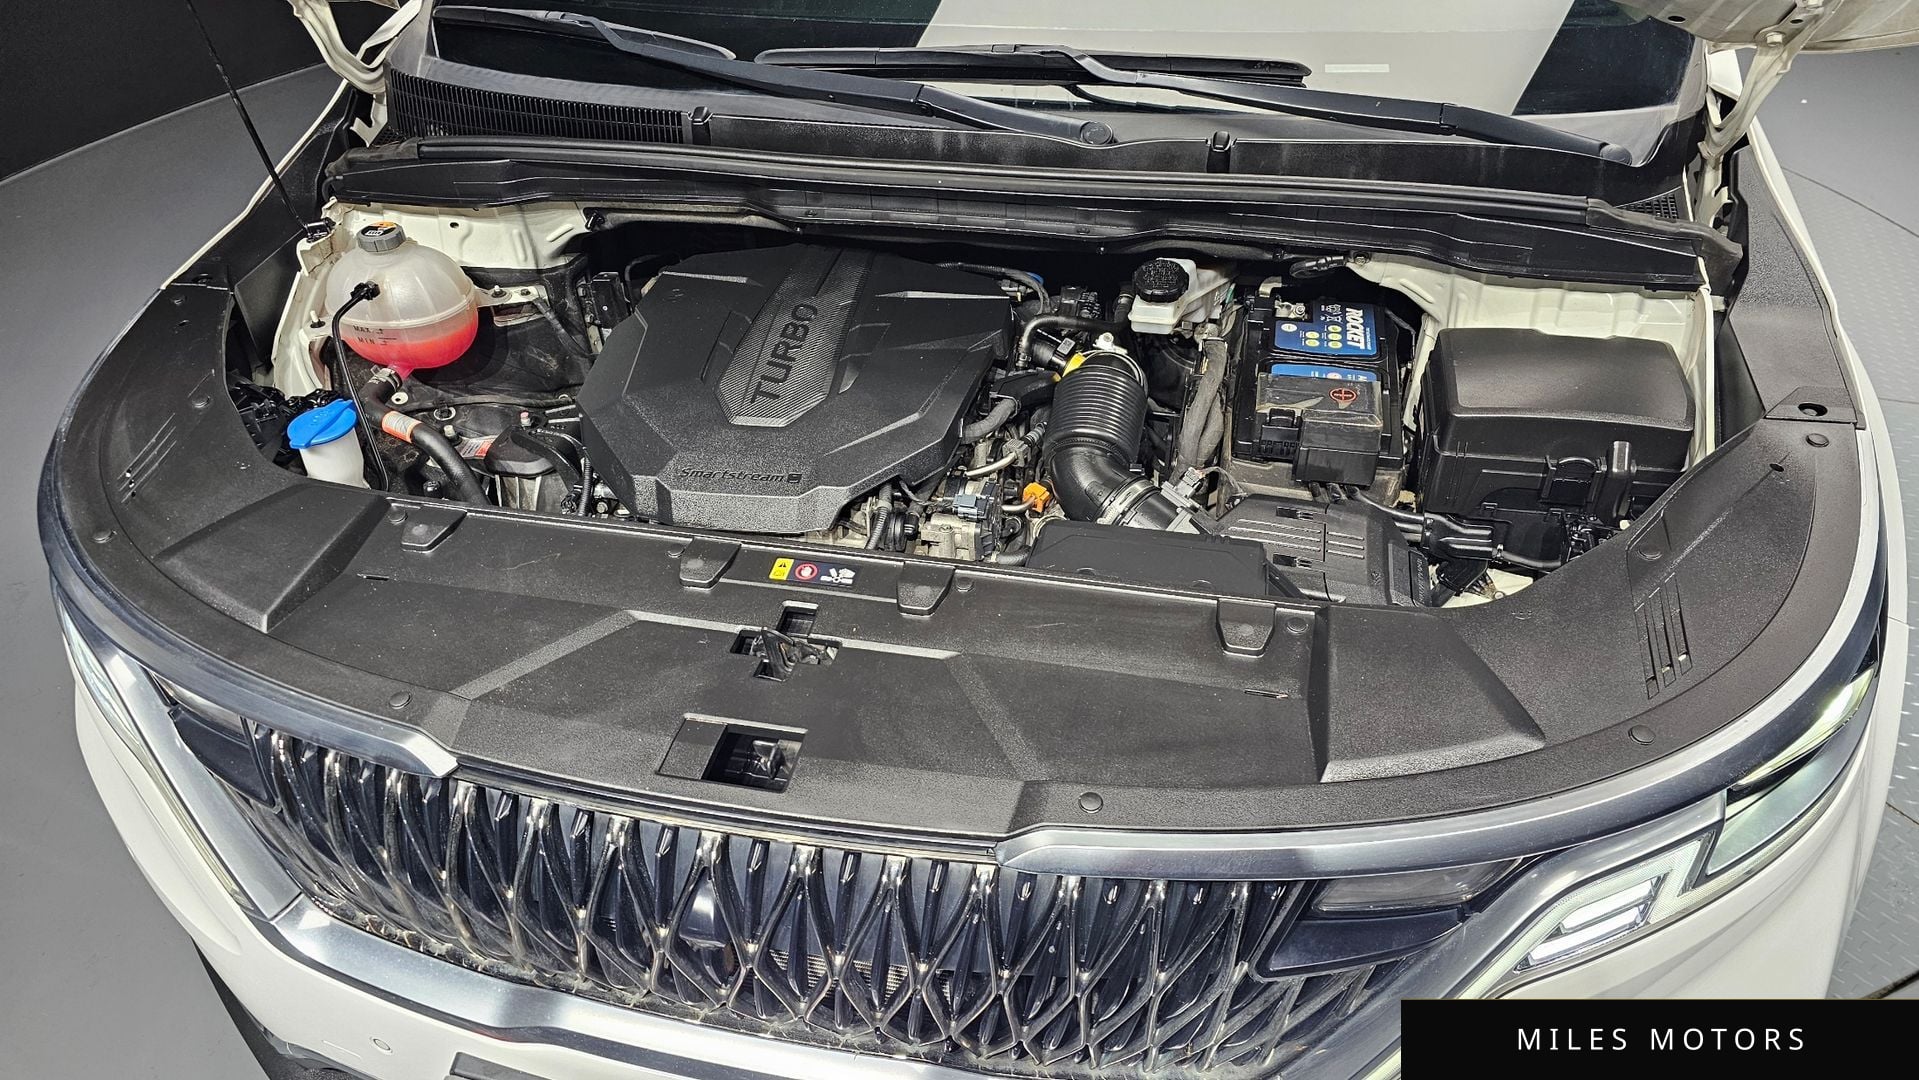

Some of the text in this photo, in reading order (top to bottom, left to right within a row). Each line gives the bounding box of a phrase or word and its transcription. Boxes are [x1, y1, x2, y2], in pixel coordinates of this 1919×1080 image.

[353, 325, 371, 334] MAX
[1345, 307, 1366, 350] ROCKET
[358, 337, 376, 345] MIN
[750, 304, 818, 404] TURBO
[680, 467, 784, 482] Smartstream
